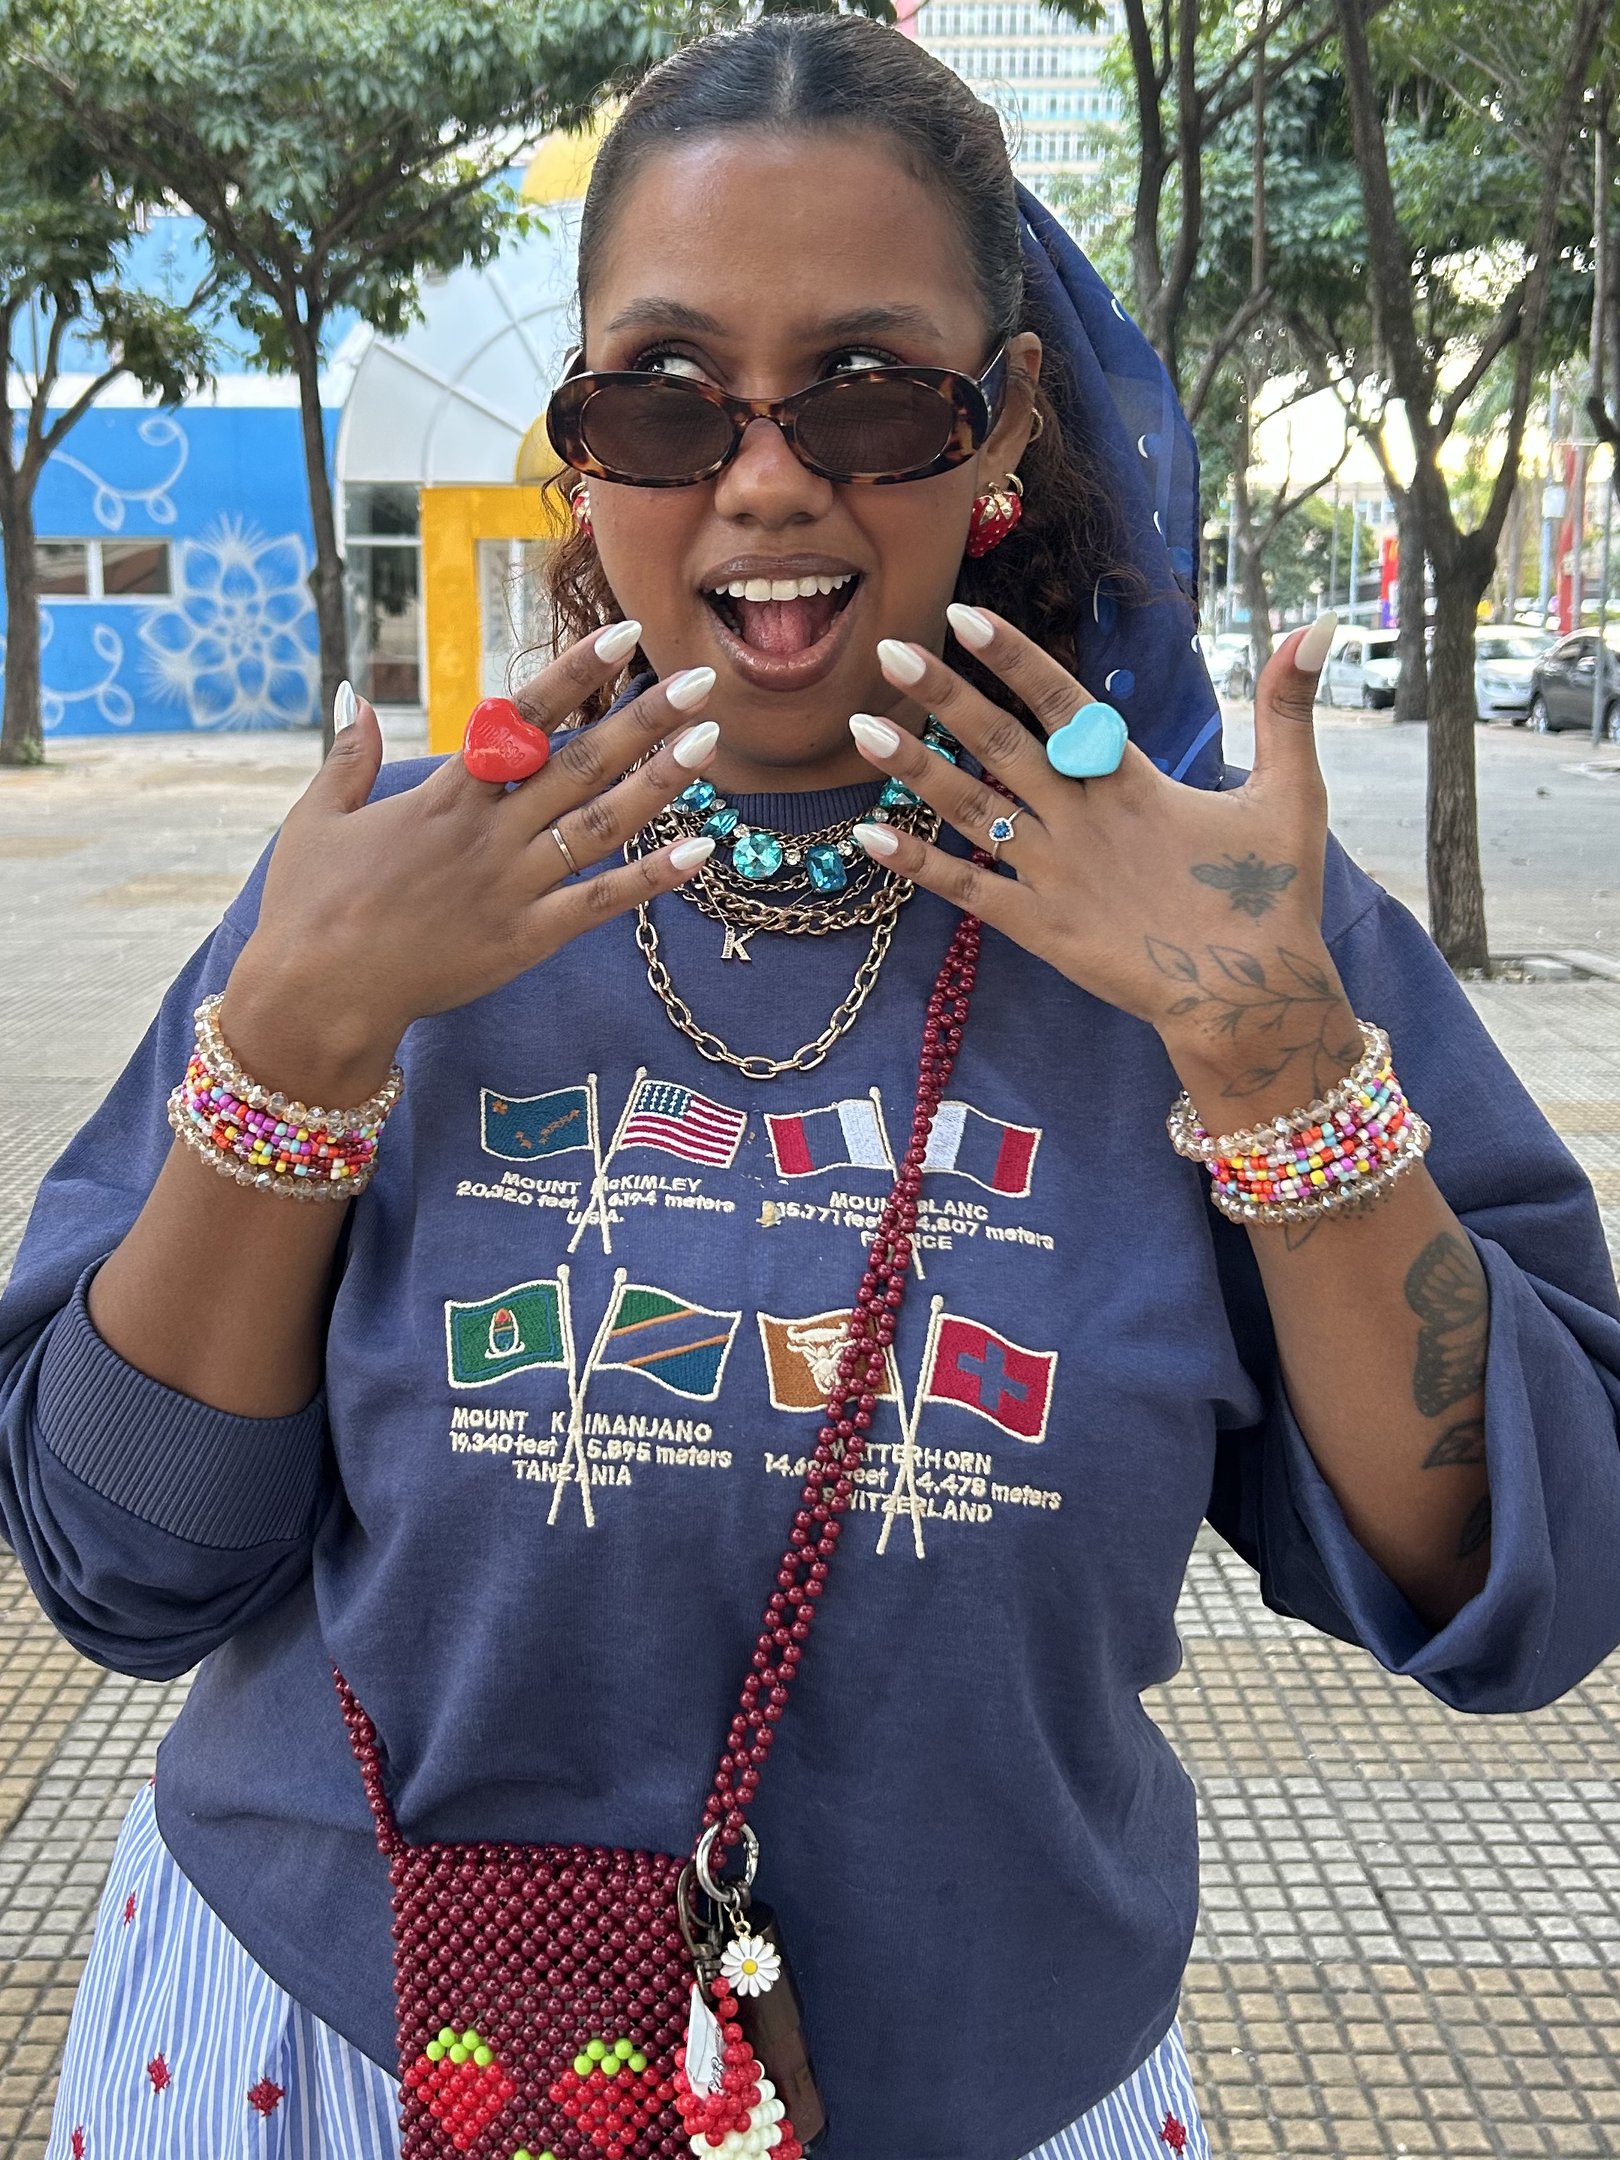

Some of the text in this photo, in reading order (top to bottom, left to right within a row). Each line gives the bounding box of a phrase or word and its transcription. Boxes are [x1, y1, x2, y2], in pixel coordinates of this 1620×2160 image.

[500, 1171, 582, 1195] MOUNT
[537, 1194, 580, 1210] feet
[664, 1193, 736, 1213] meters
[829, 1191, 989, 1221] MOUN BLANC
[985, 1225, 1055, 1250] meters
[450, 1406, 529, 1431] MOUNT
[512, 1433, 559, 1457] feet
[655, 1444, 733, 1468] meters
[828, 1437, 992, 1476] MTTERHORN
[991, 1482, 1063, 1511] meters
